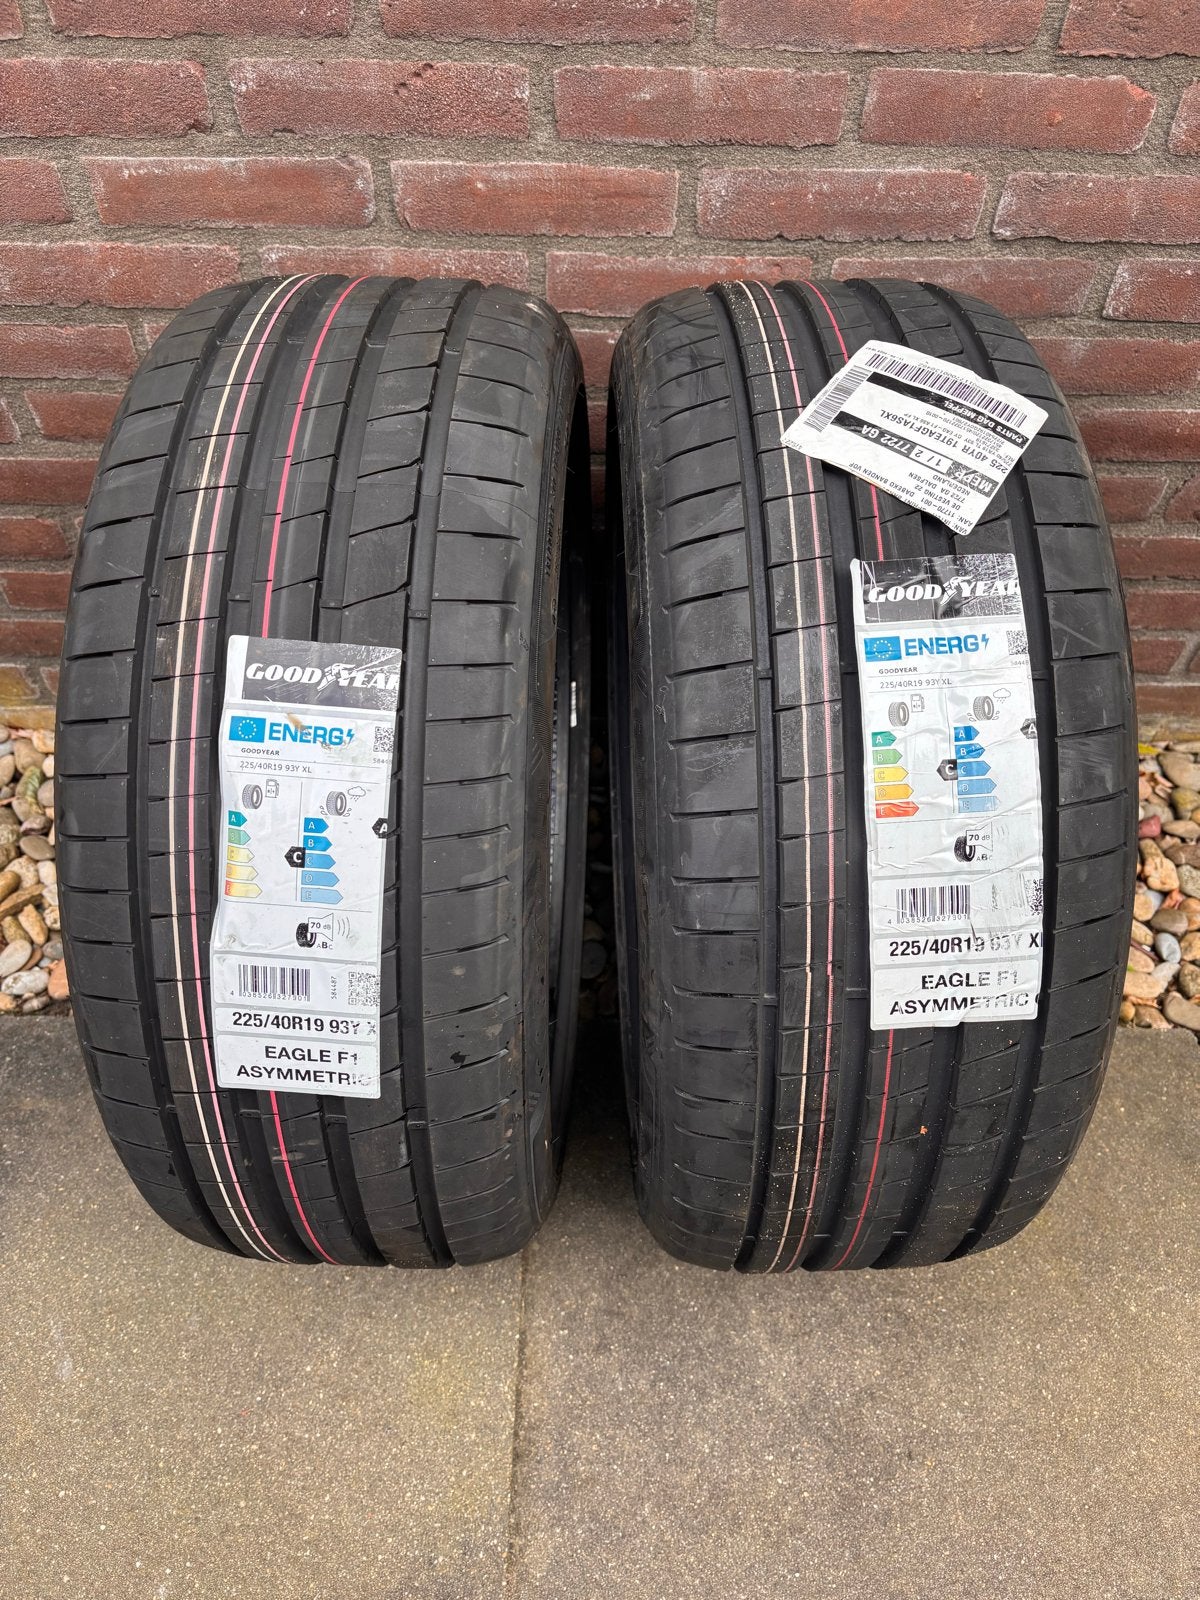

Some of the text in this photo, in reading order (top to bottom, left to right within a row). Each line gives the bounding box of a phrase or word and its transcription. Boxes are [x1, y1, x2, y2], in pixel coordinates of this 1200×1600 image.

[942, 399, 975, 418] MEPPEL
[878, 408, 959, 448] 19TEAGF1AS6XL
[976, 415, 995, 428] DAG
[860, 423, 879, 439] GA
[995, 425, 1022, 442] PARTS
[880, 432, 910, 452] 7722
[960, 443, 988, 463] 40YR
[988, 458, 1008, 474] 225
[862, 467, 888, 484] BANDEN
[908, 471, 937, 489] DALFSEN
[932, 473, 970, 496] NEDERLAND
[914, 483, 960, 510] DE VESTING 22
[955, 514, 973, 527] AAN:
[880, 680, 923, 689] 225/40R19
[958, 730, 965, 738] A
[1028, 723, 1037, 733] A
[876, 736, 883, 744] A
[241, 747, 280, 756] GOODYEAR
[240, 761, 282, 771] 225/40R19
[285, 764, 301, 772] 93Y
[945, 764, 954, 775] C
[308, 839, 314, 847] B
[293, 852, 302, 863] C
[889, 936, 985, 956] 225/40R19
[921, 971, 991, 990] EAGLE
[232, 1012, 324, 1032] 225/40R19
[329, 1020, 360, 1035] 93Y
[264, 1046, 358, 1066] EAGLE F1
